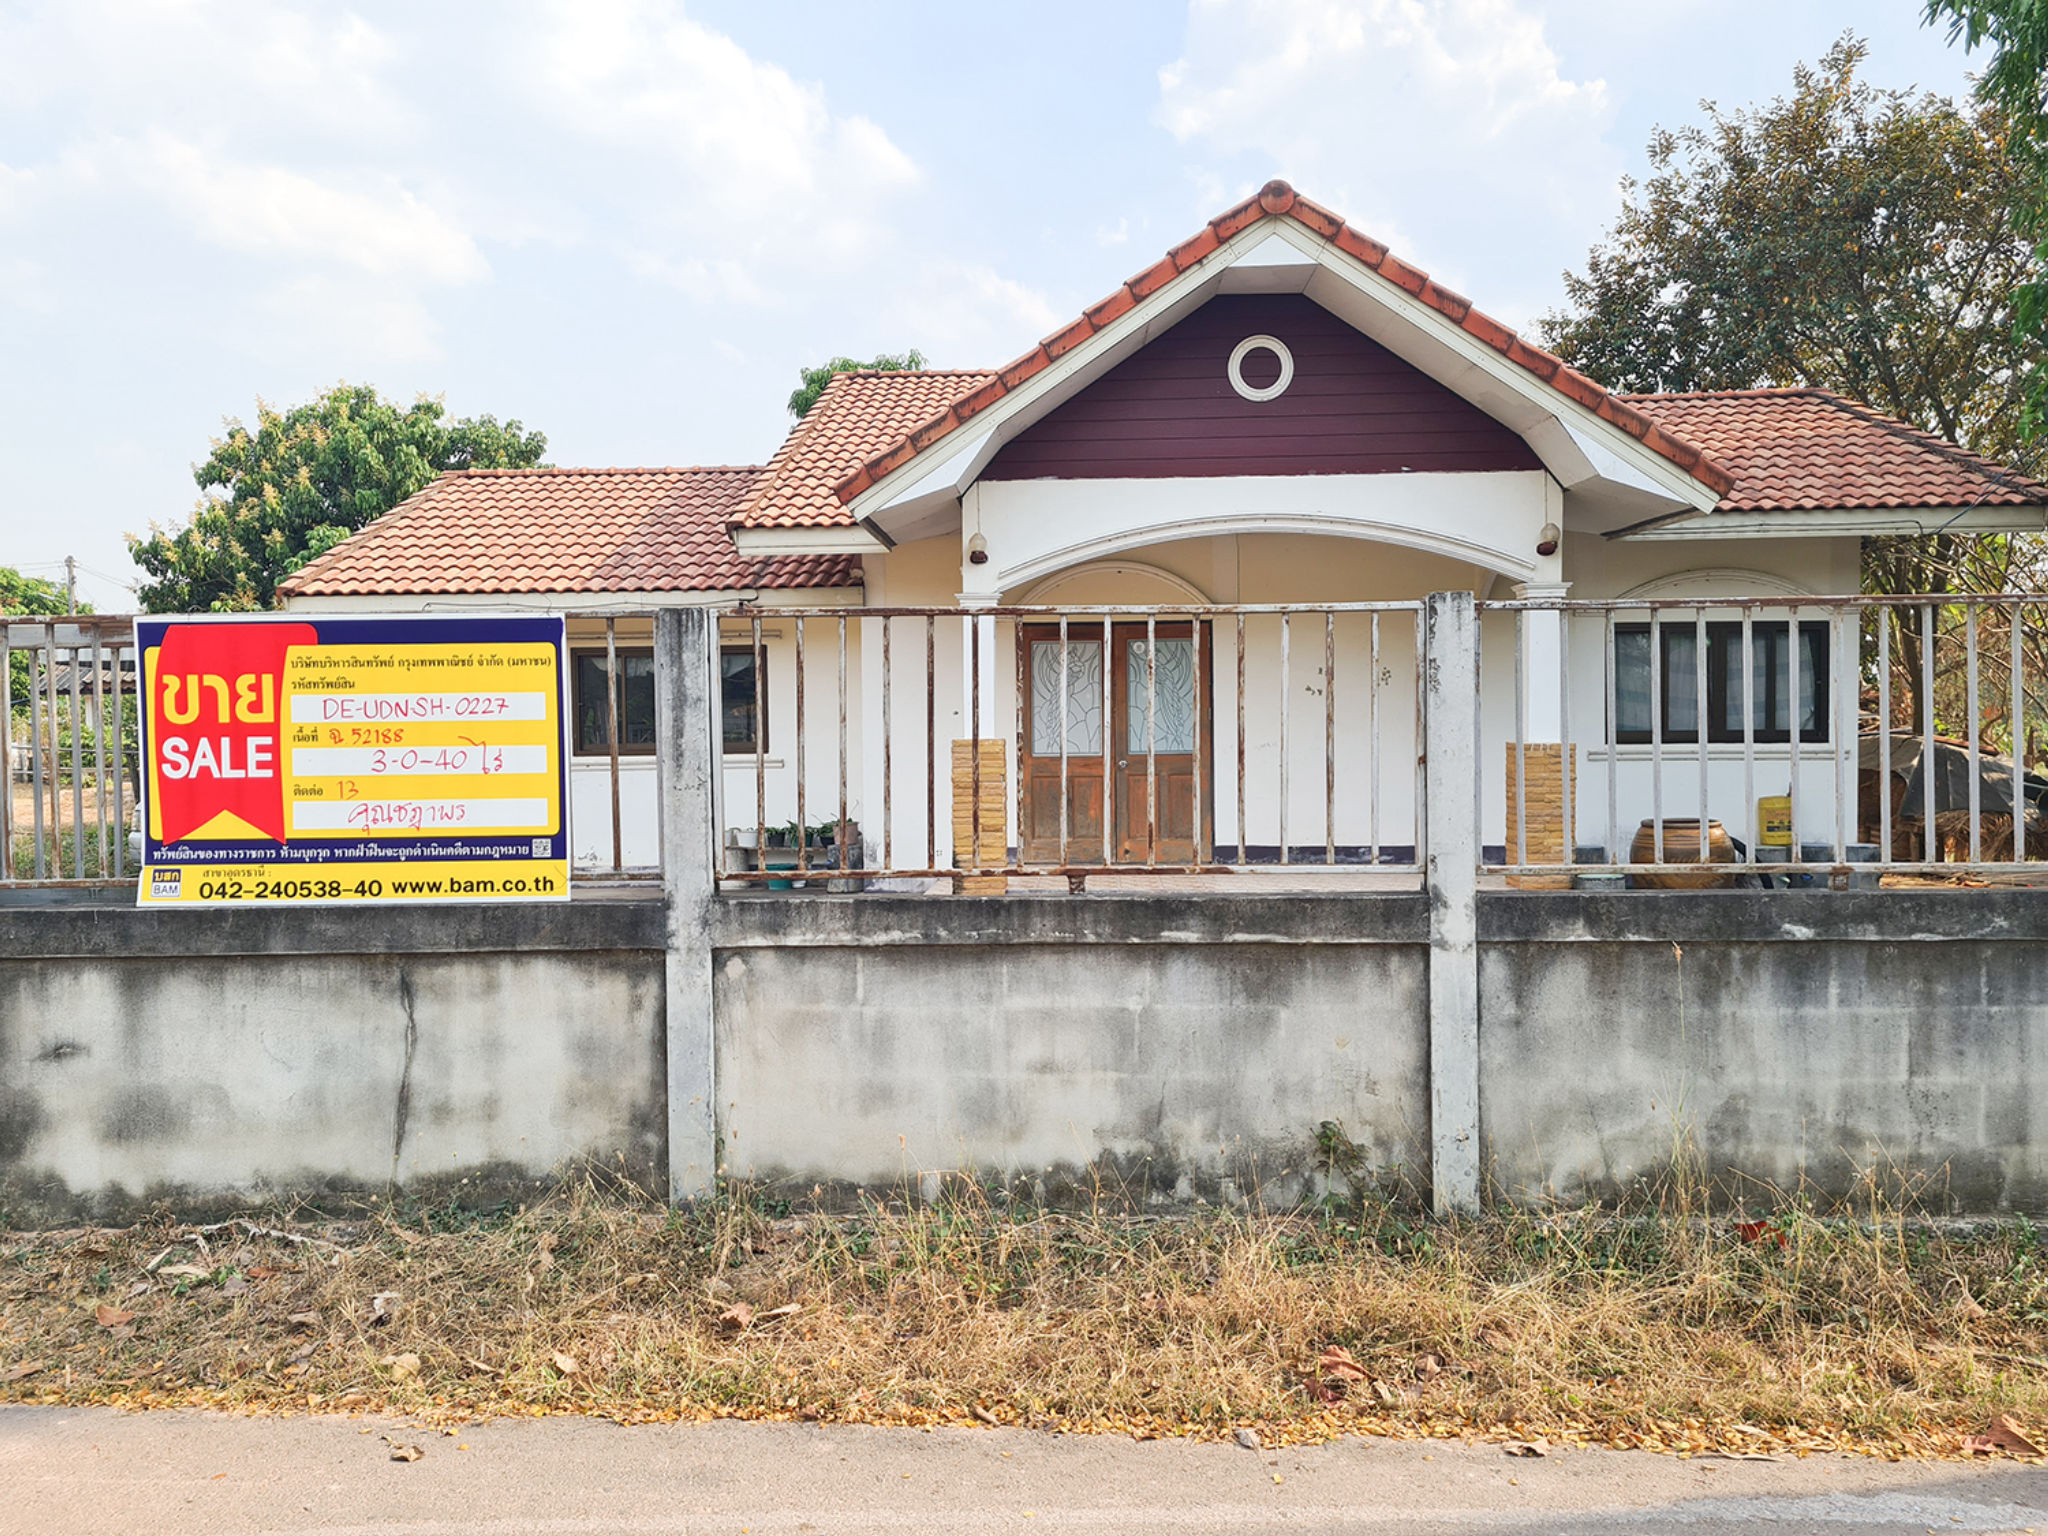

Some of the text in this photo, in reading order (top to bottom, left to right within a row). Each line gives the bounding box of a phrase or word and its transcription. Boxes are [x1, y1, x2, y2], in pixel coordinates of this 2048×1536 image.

[291, 654, 552, 672] บริษัทบริหารสินทรัพย์ กรุงเทพพาณิชย์ จำกัด (มหาชน)
[291, 675, 356, 690] รหัสทรัพย์สิน
[162, 673, 275, 725] ขาย
[293, 726, 319, 743] เนื้อที่
[351, 727, 405, 745] 52188
[161, 736, 274, 780] SALE
[293, 783, 324, 797] ติดต่อ
[153, 845, 276, 861] ทรัพย์สินของทางราชการ
[280, 845, 331, 863] ห้ามบุกรุก
[154, 870, 180, 882] บสก
[153, 884, 179, 895] BAM
[199, 876, 555, 900] 042-240538-40 www.bam.co.th
